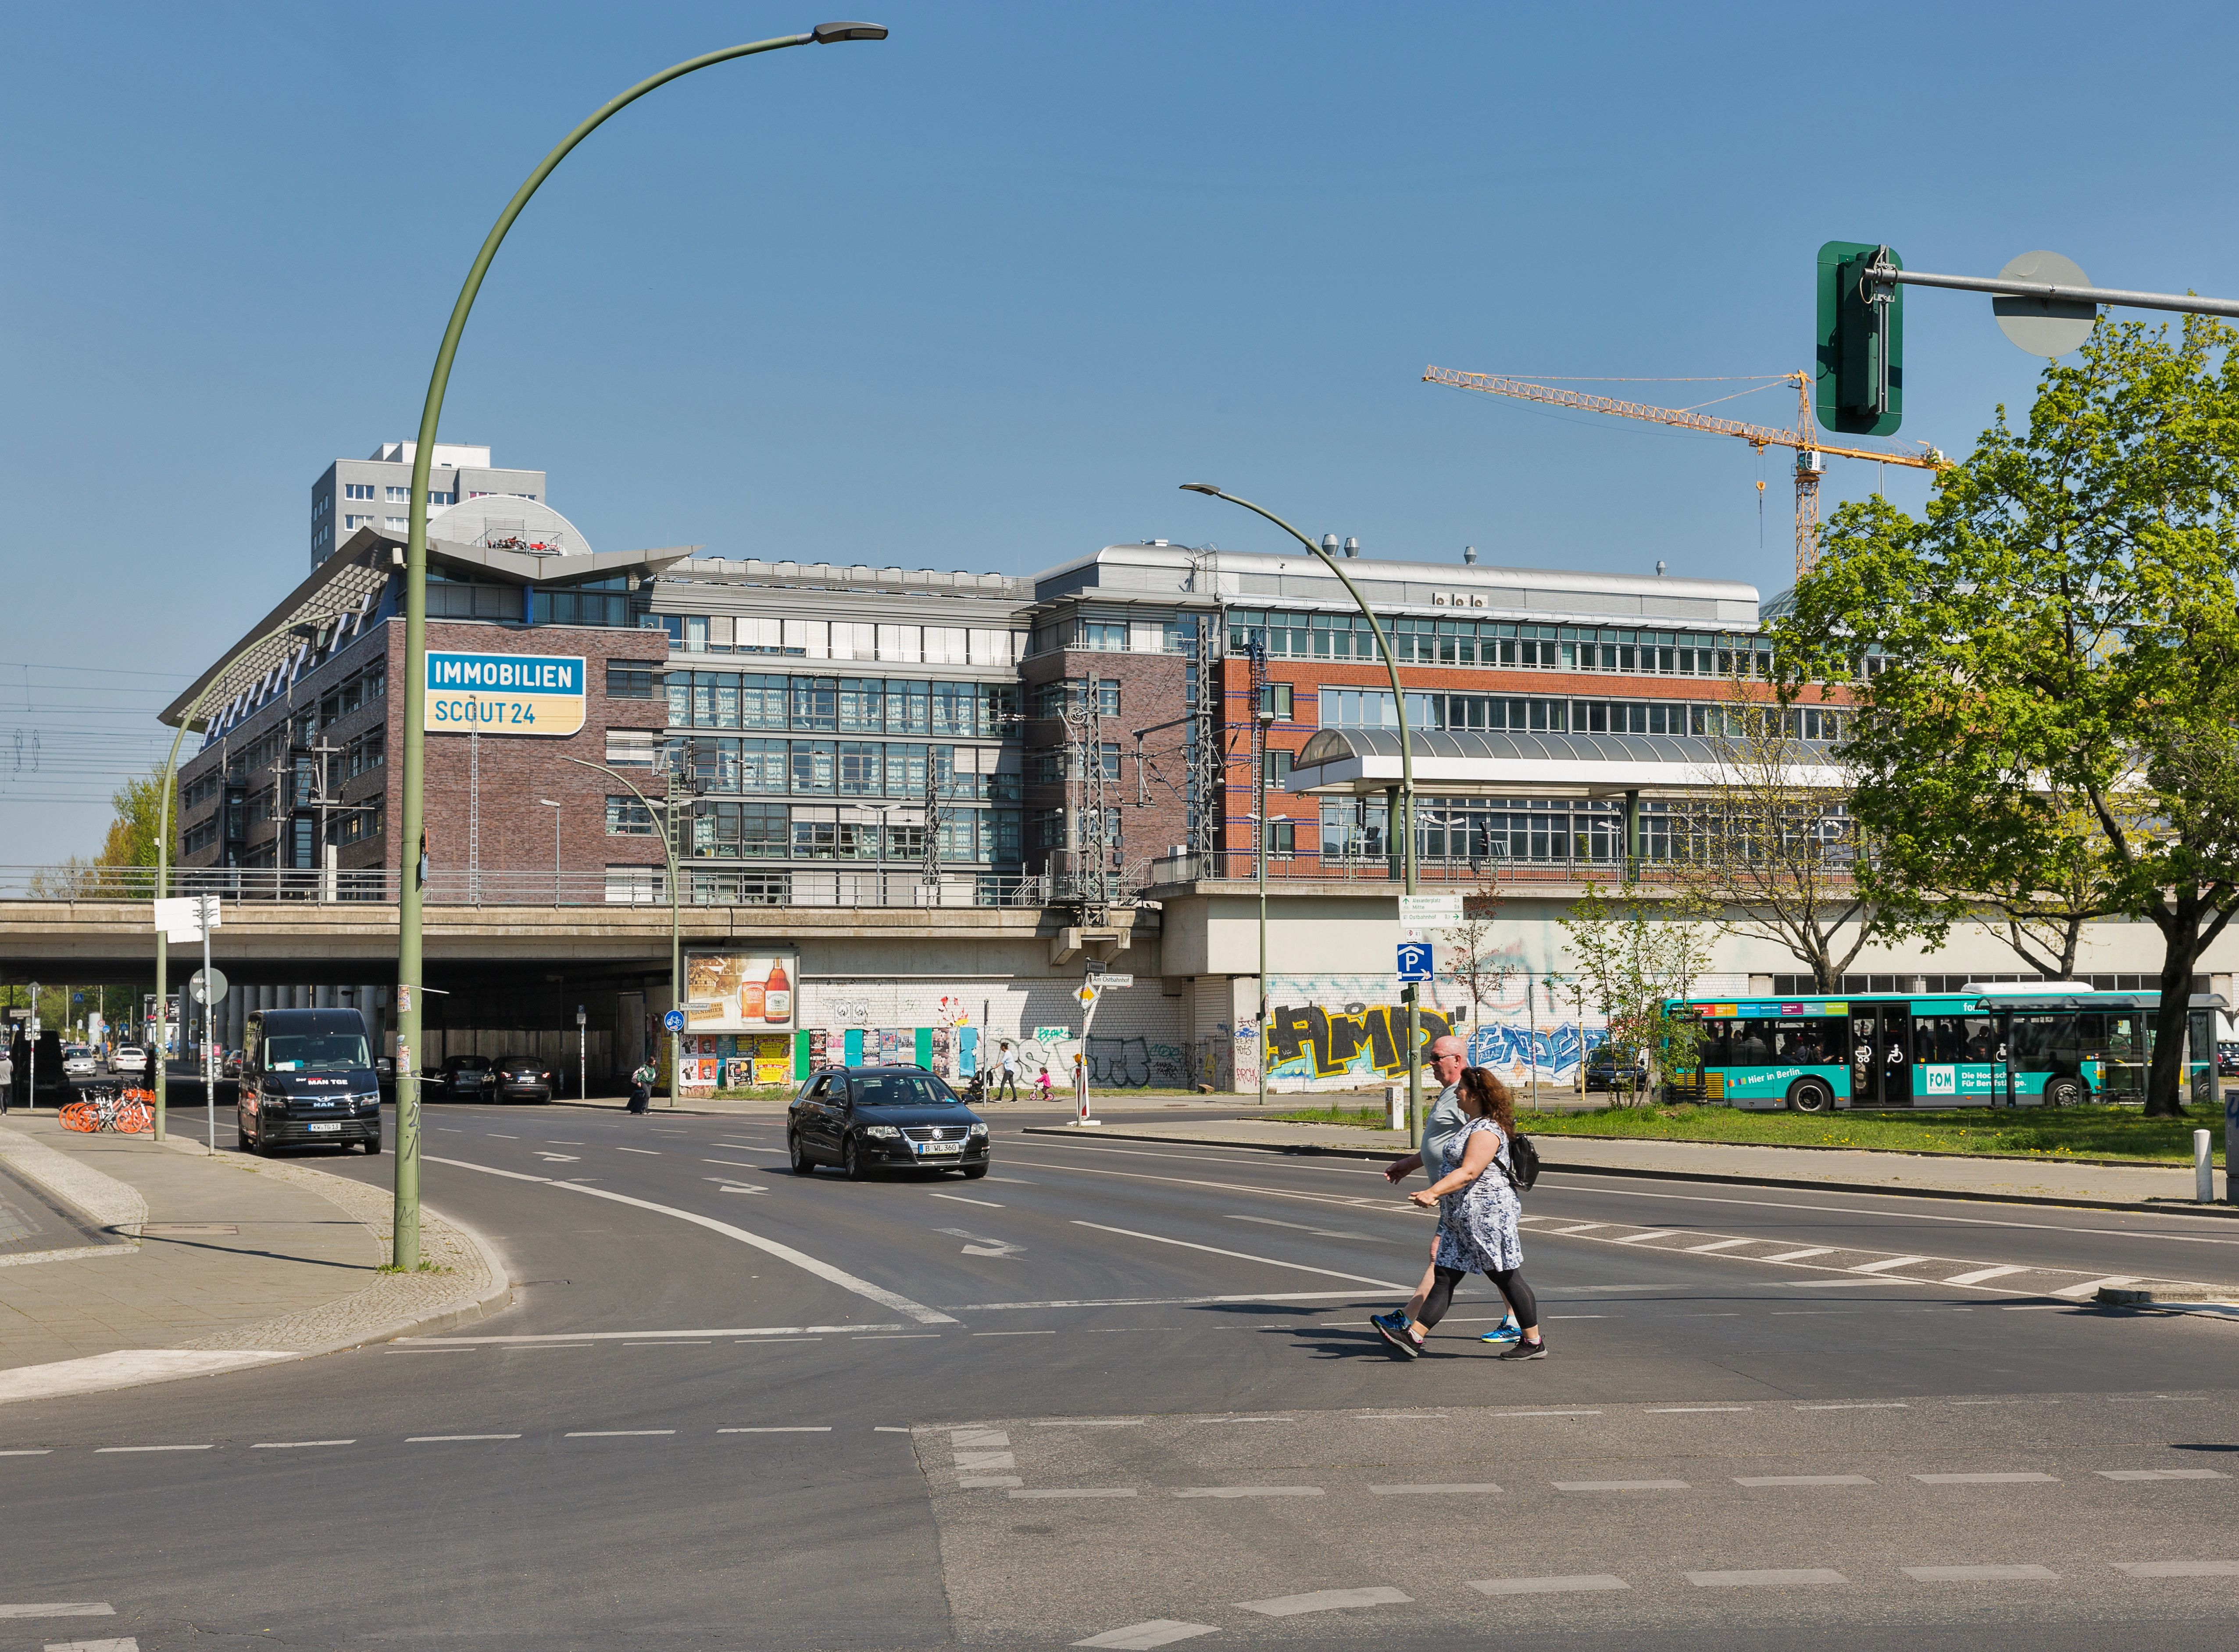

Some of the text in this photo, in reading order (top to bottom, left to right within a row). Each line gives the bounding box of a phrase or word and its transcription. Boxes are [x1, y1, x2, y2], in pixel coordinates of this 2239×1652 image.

[436, 661, 571, 688] IMMOBILIEN
[436, 700, 535, 724] SCOUT 24
[1406, 953, 1418, 971] P
[1748, 1067, 1803, 1084] Hier in Berlin.
[1929, 1073, 1952, 1087] FOM
